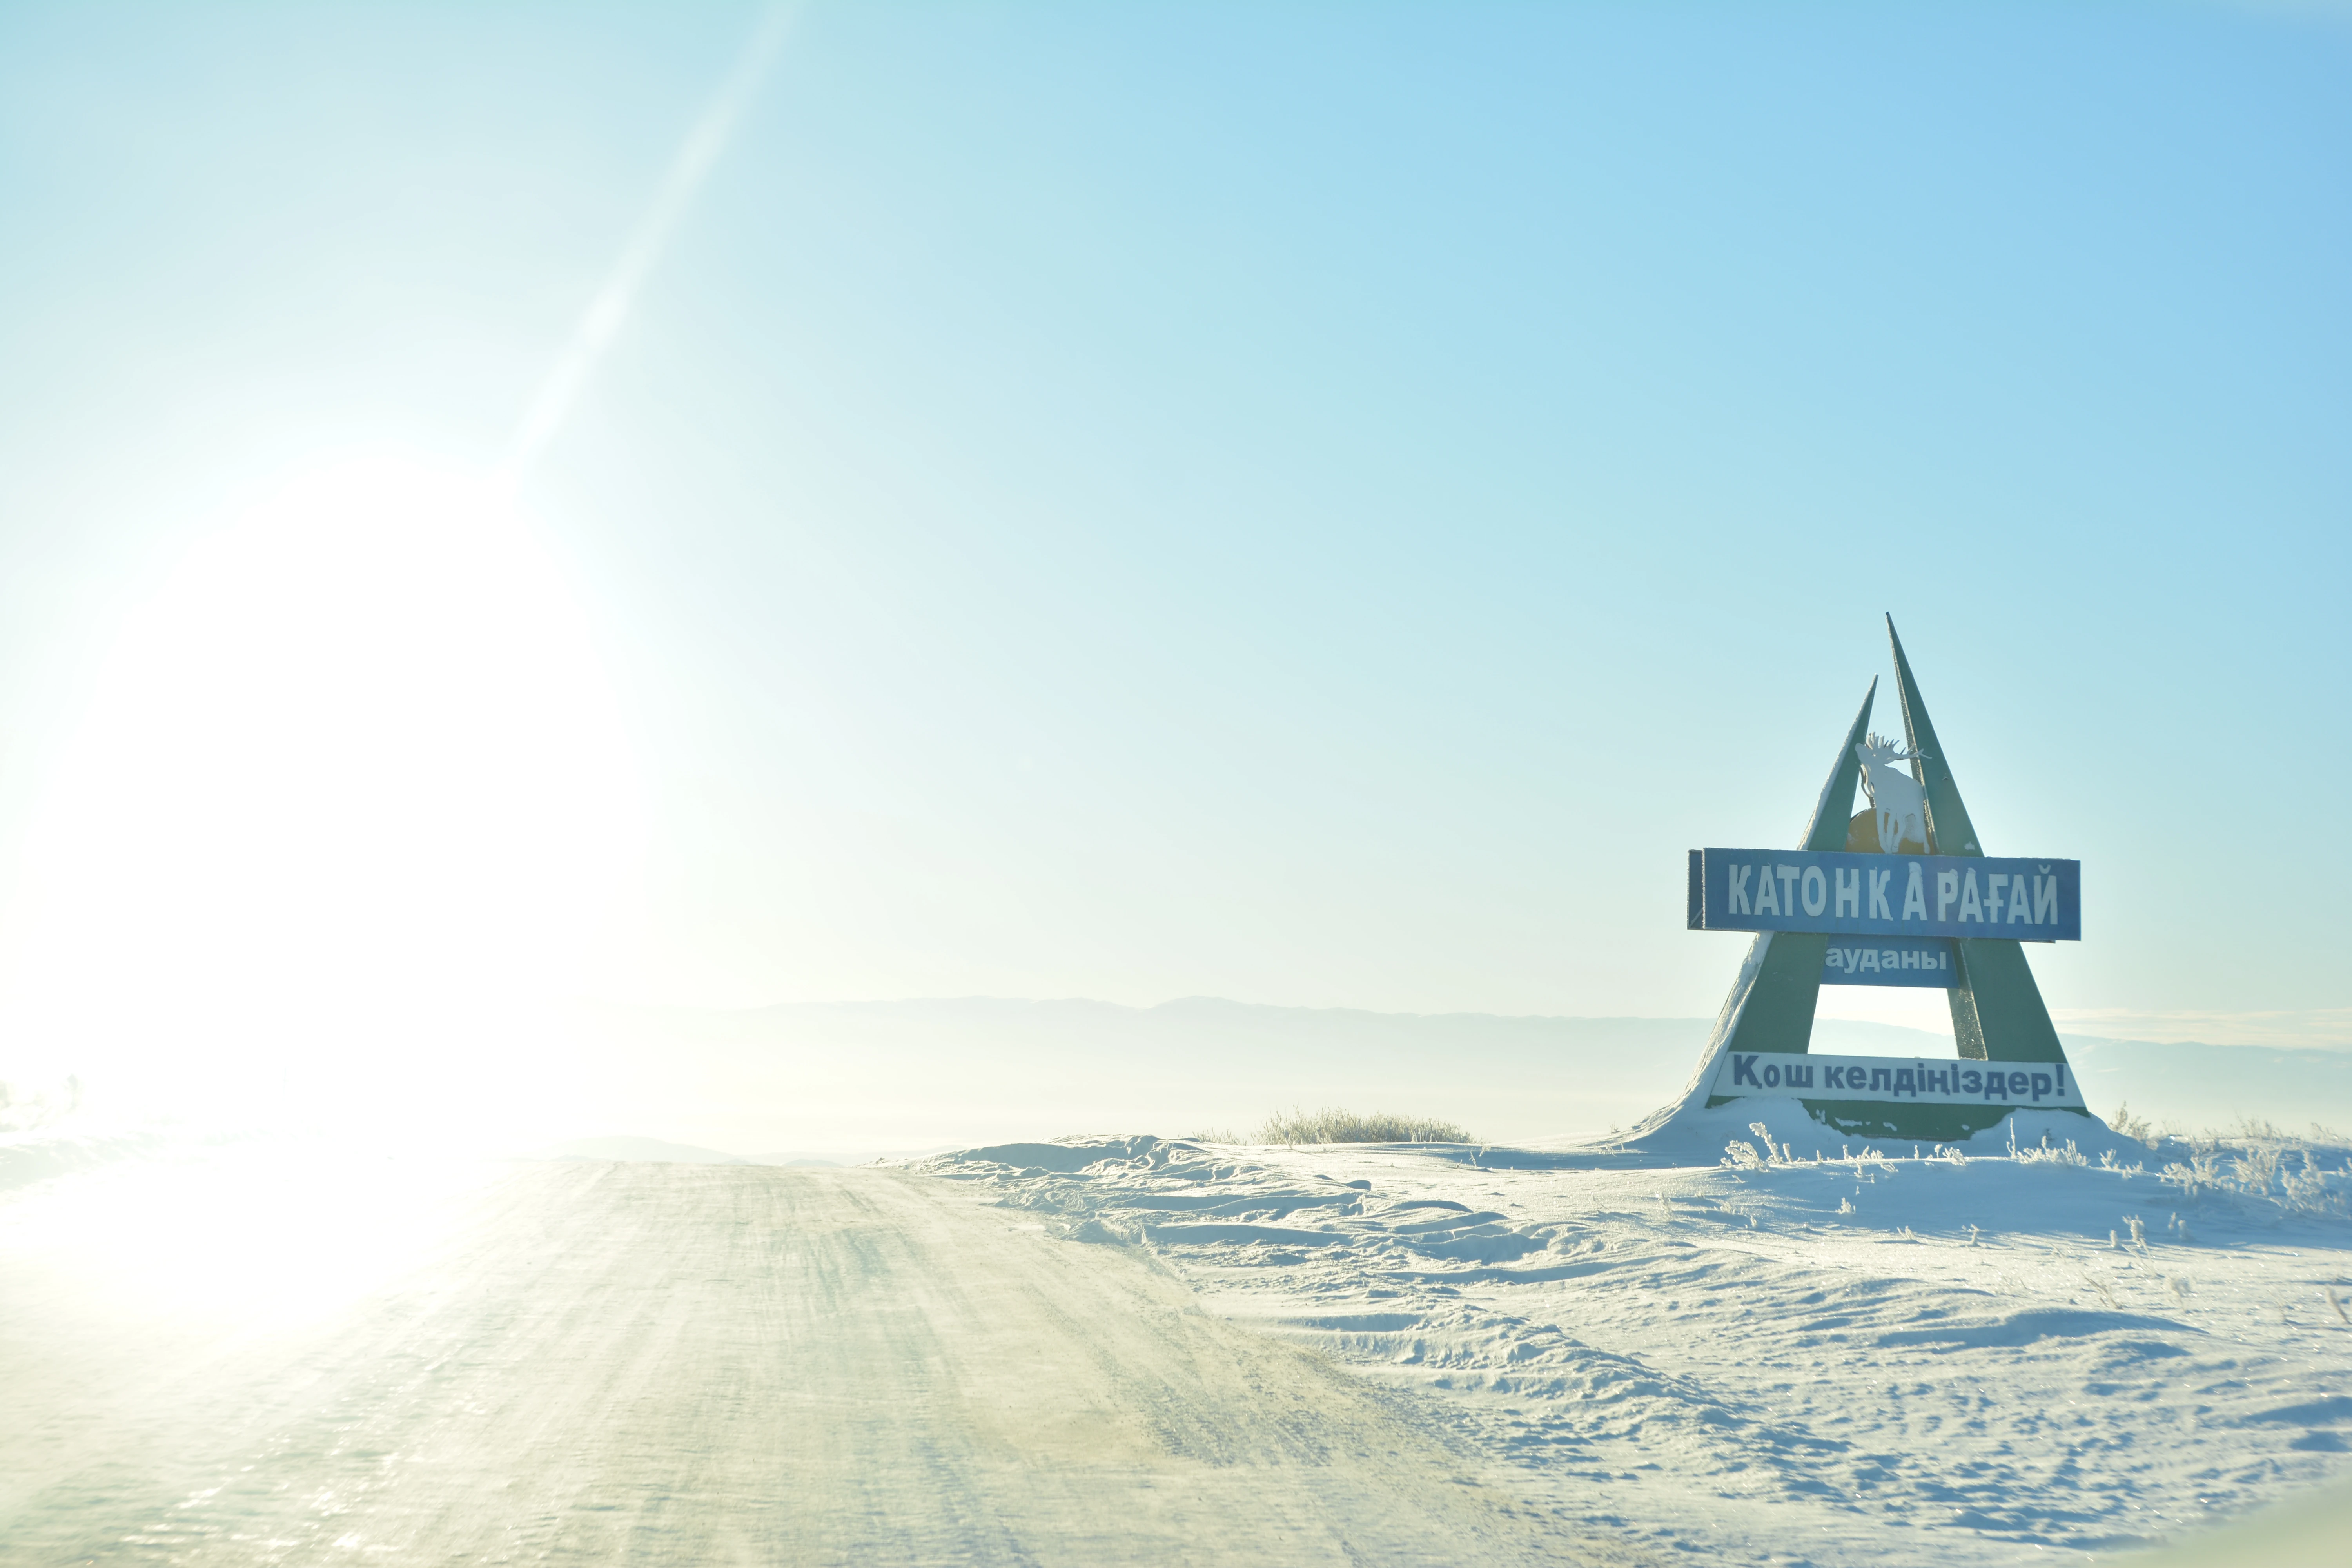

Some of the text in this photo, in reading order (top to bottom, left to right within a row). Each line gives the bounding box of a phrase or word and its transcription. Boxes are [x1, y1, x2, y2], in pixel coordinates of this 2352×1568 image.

[1825, 948, 1947, 974] ауданы
[1734, 1055, 2065, 1101] Қош келдіңіздер!
